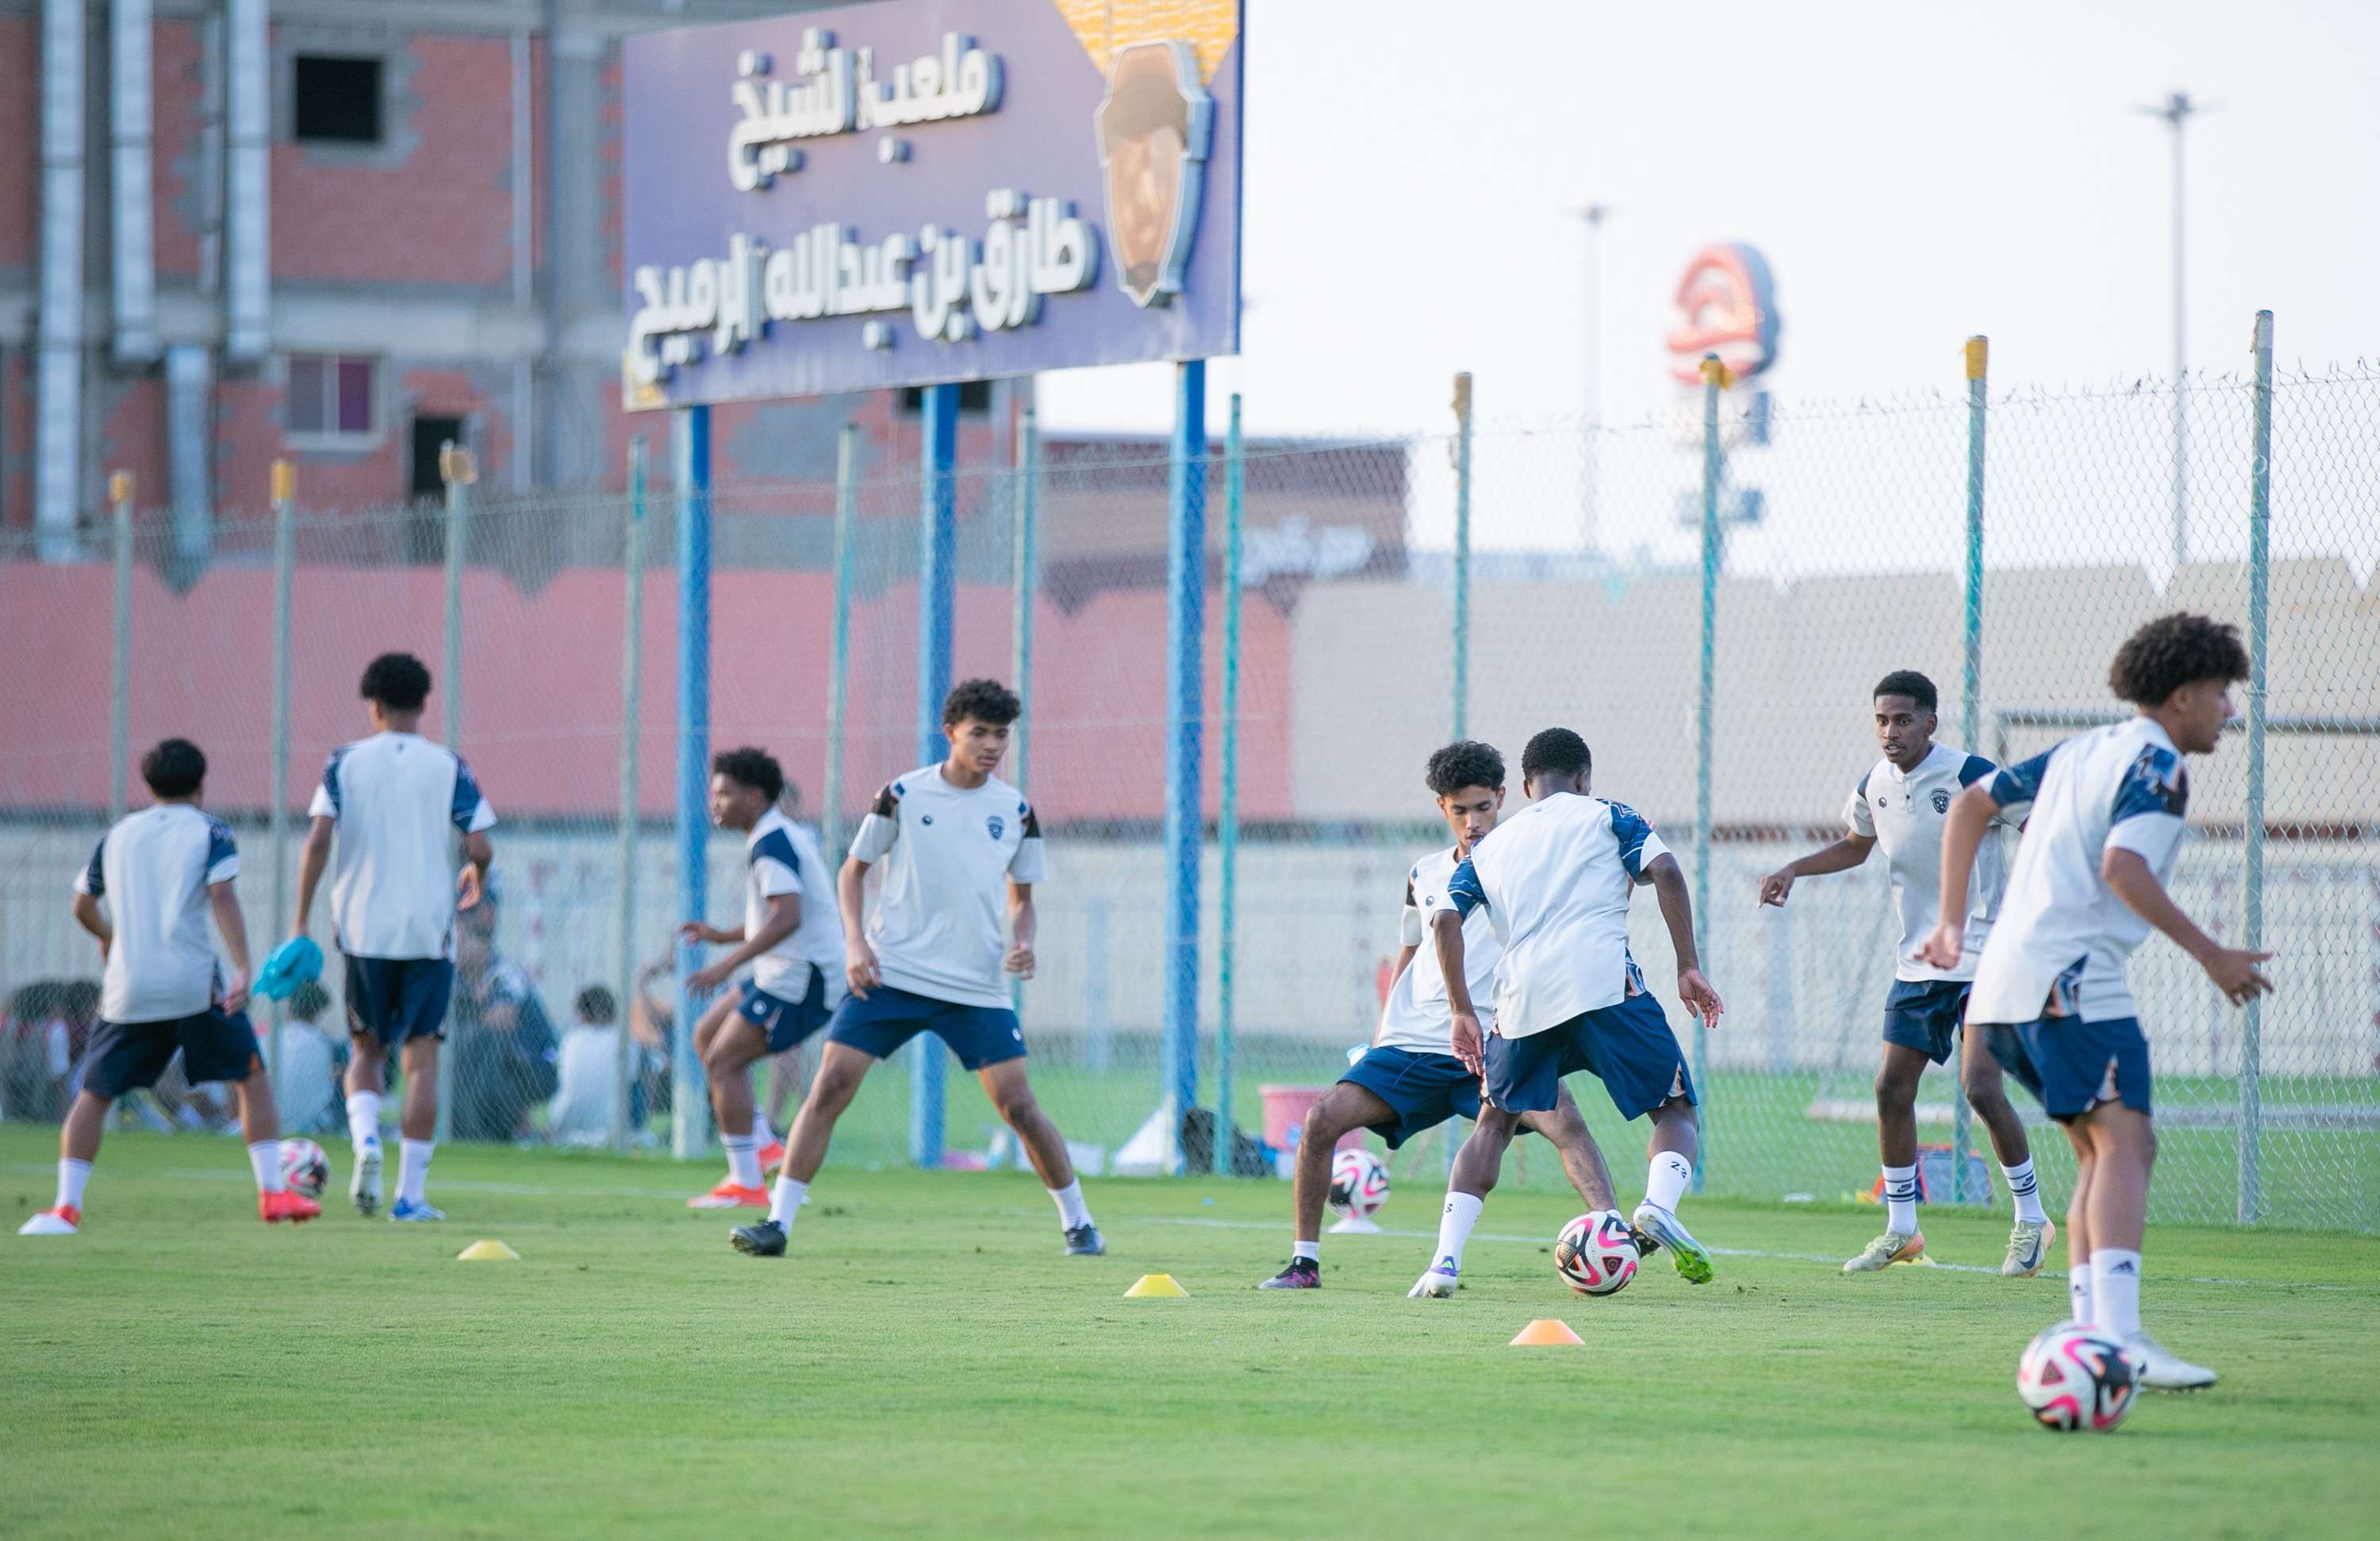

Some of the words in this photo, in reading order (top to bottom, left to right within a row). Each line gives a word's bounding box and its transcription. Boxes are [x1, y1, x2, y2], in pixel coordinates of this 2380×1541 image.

[868, 31, 993, 164] ملعب
[912, 222, 967, 343] بن
[969, 187, 1090, 332] طارق
